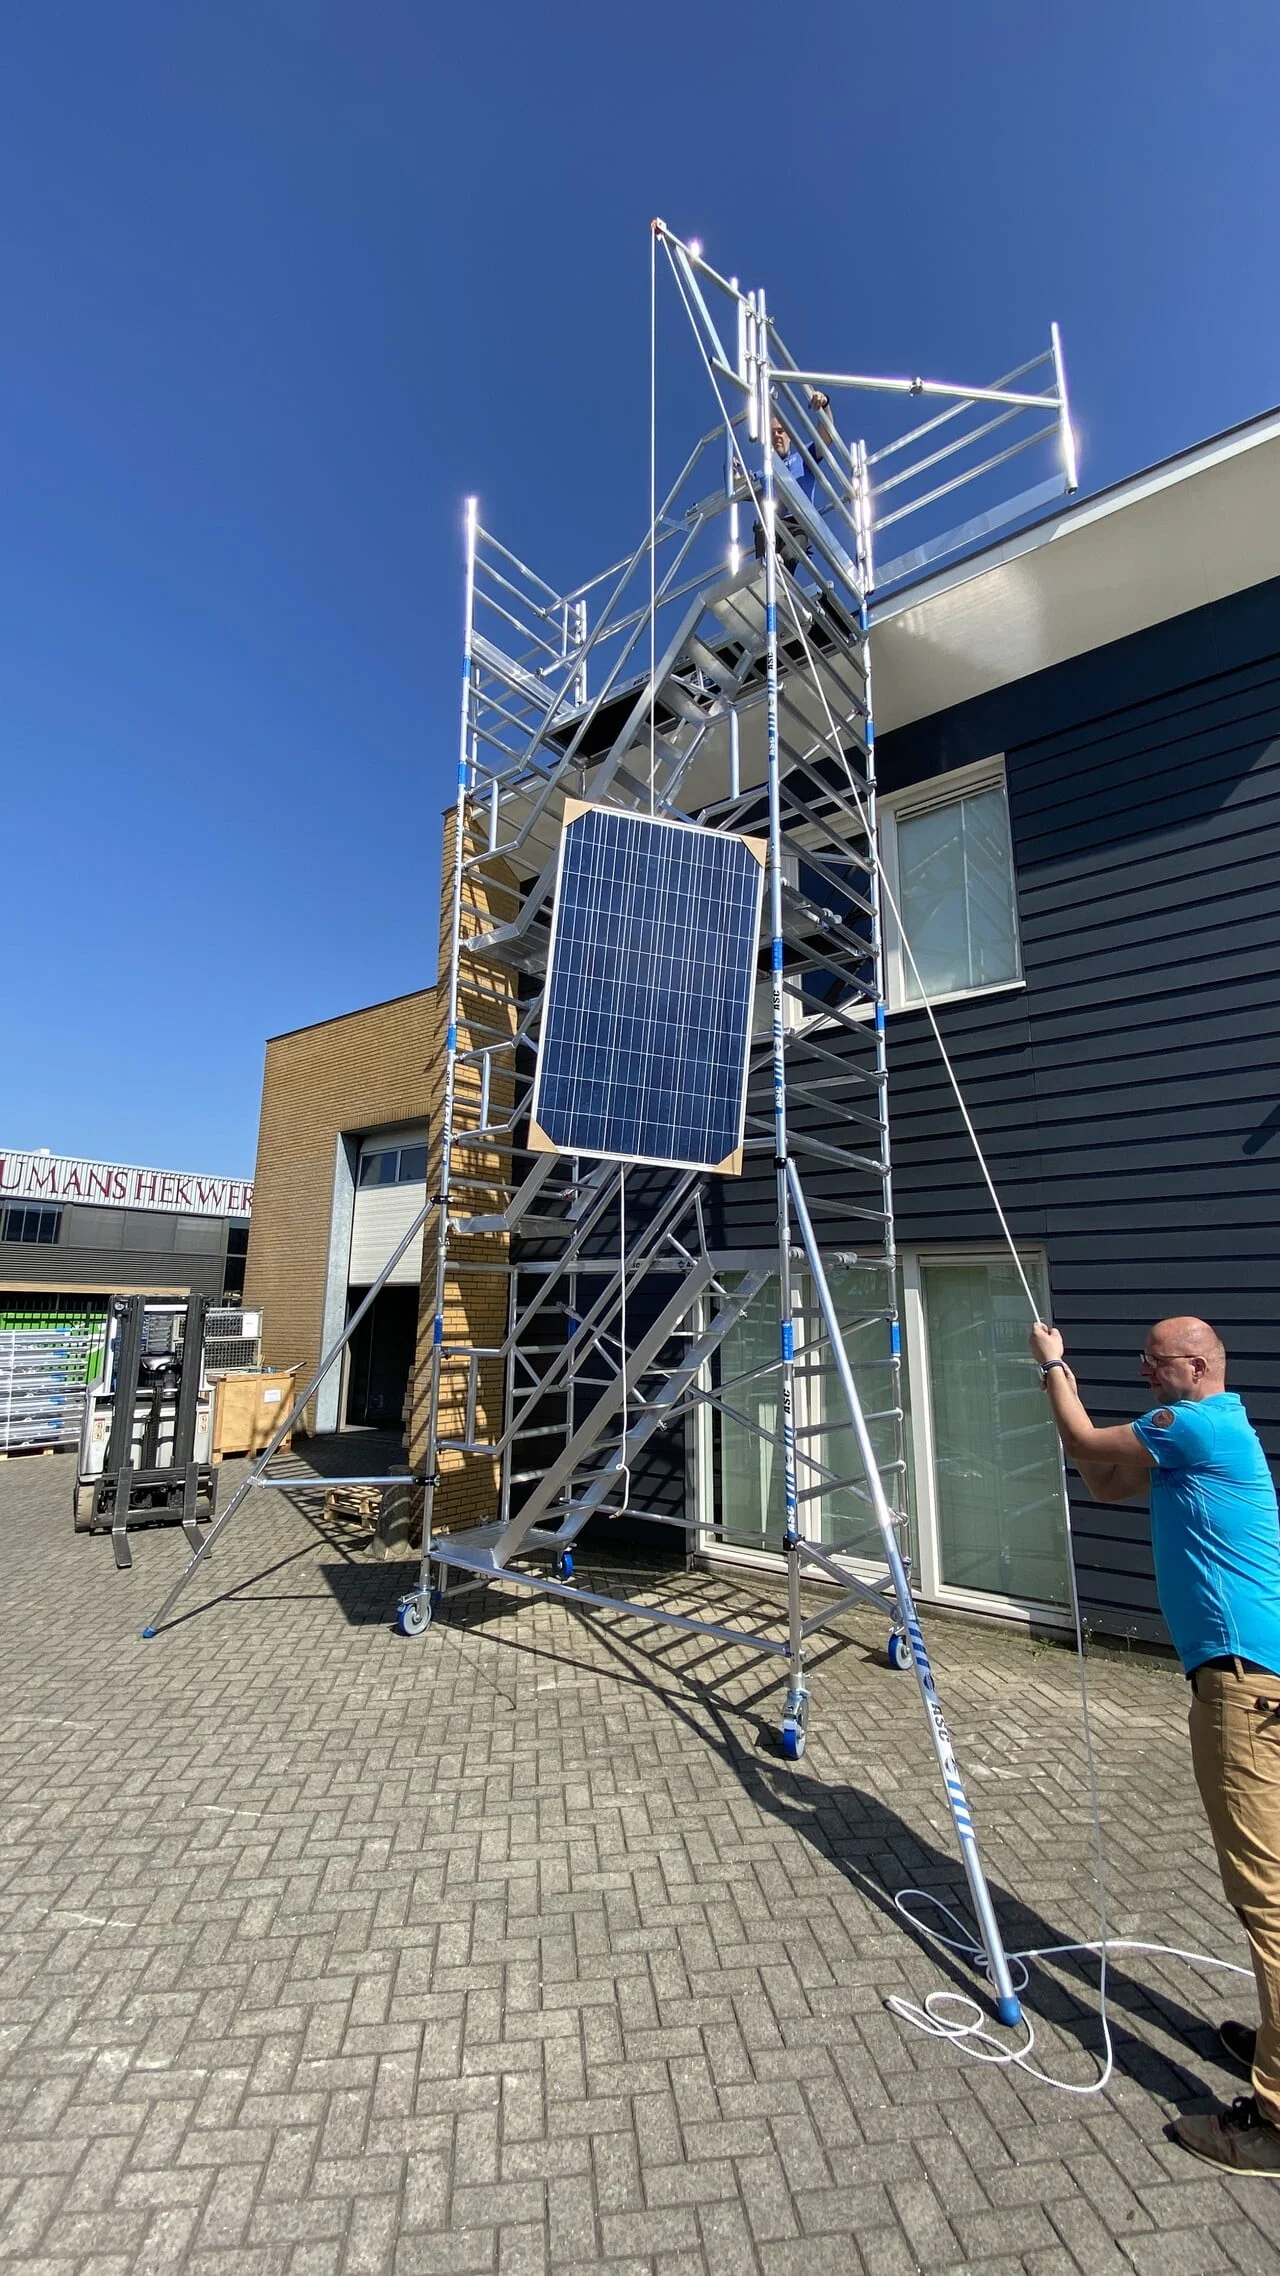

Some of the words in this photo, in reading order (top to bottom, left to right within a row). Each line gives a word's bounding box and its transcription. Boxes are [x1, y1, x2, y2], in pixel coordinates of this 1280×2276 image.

[0, 1160, 128, 1199] UMANS
[783, 1388, 791, 1414] ASC
[786, 1504, 796, 1533] ASC
[931, 1703, 950, 1743] ASC
